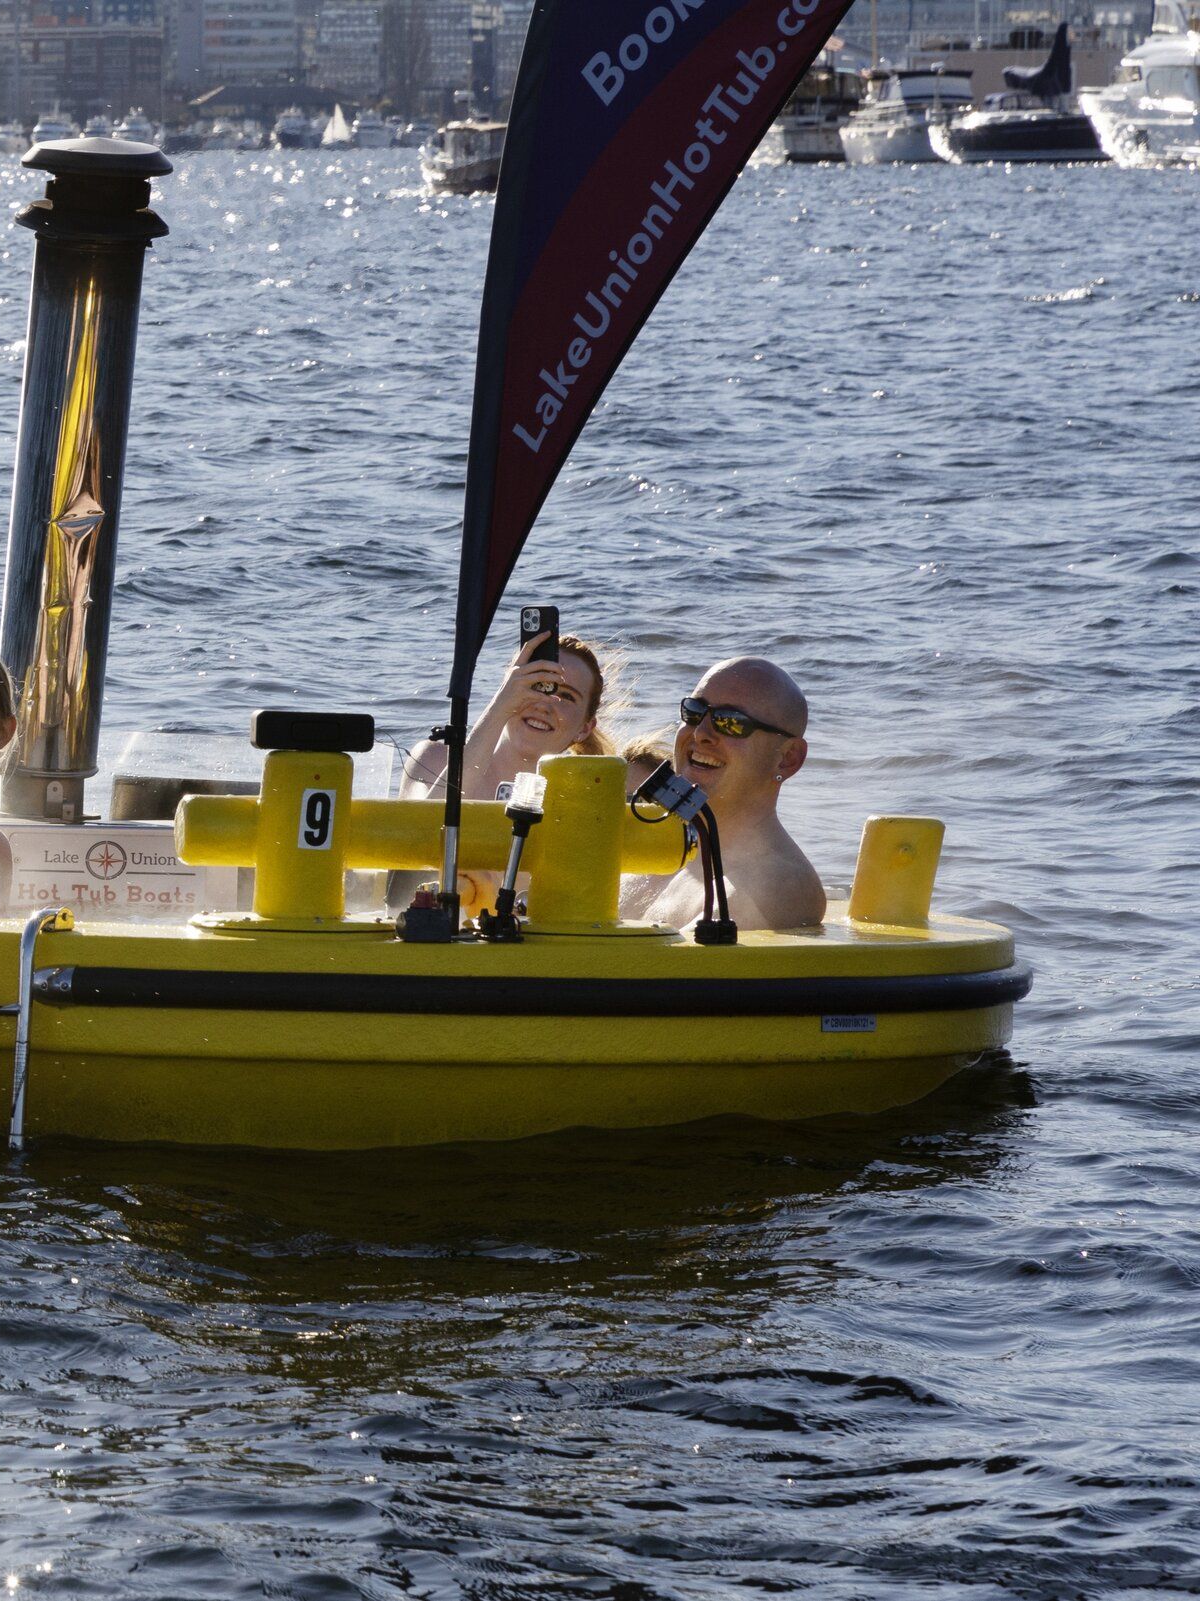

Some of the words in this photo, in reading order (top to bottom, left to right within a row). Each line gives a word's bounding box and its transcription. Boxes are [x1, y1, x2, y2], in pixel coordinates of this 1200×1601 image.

[304, 792, 332, 847] 9
[44, 850, 79, 864] Lake
[131, 852, 177, 866] Union
[18, 883, 60, 901] Hot
[72, 884, 117, 902] Tub
[127, 885, 196, 904] Boats
